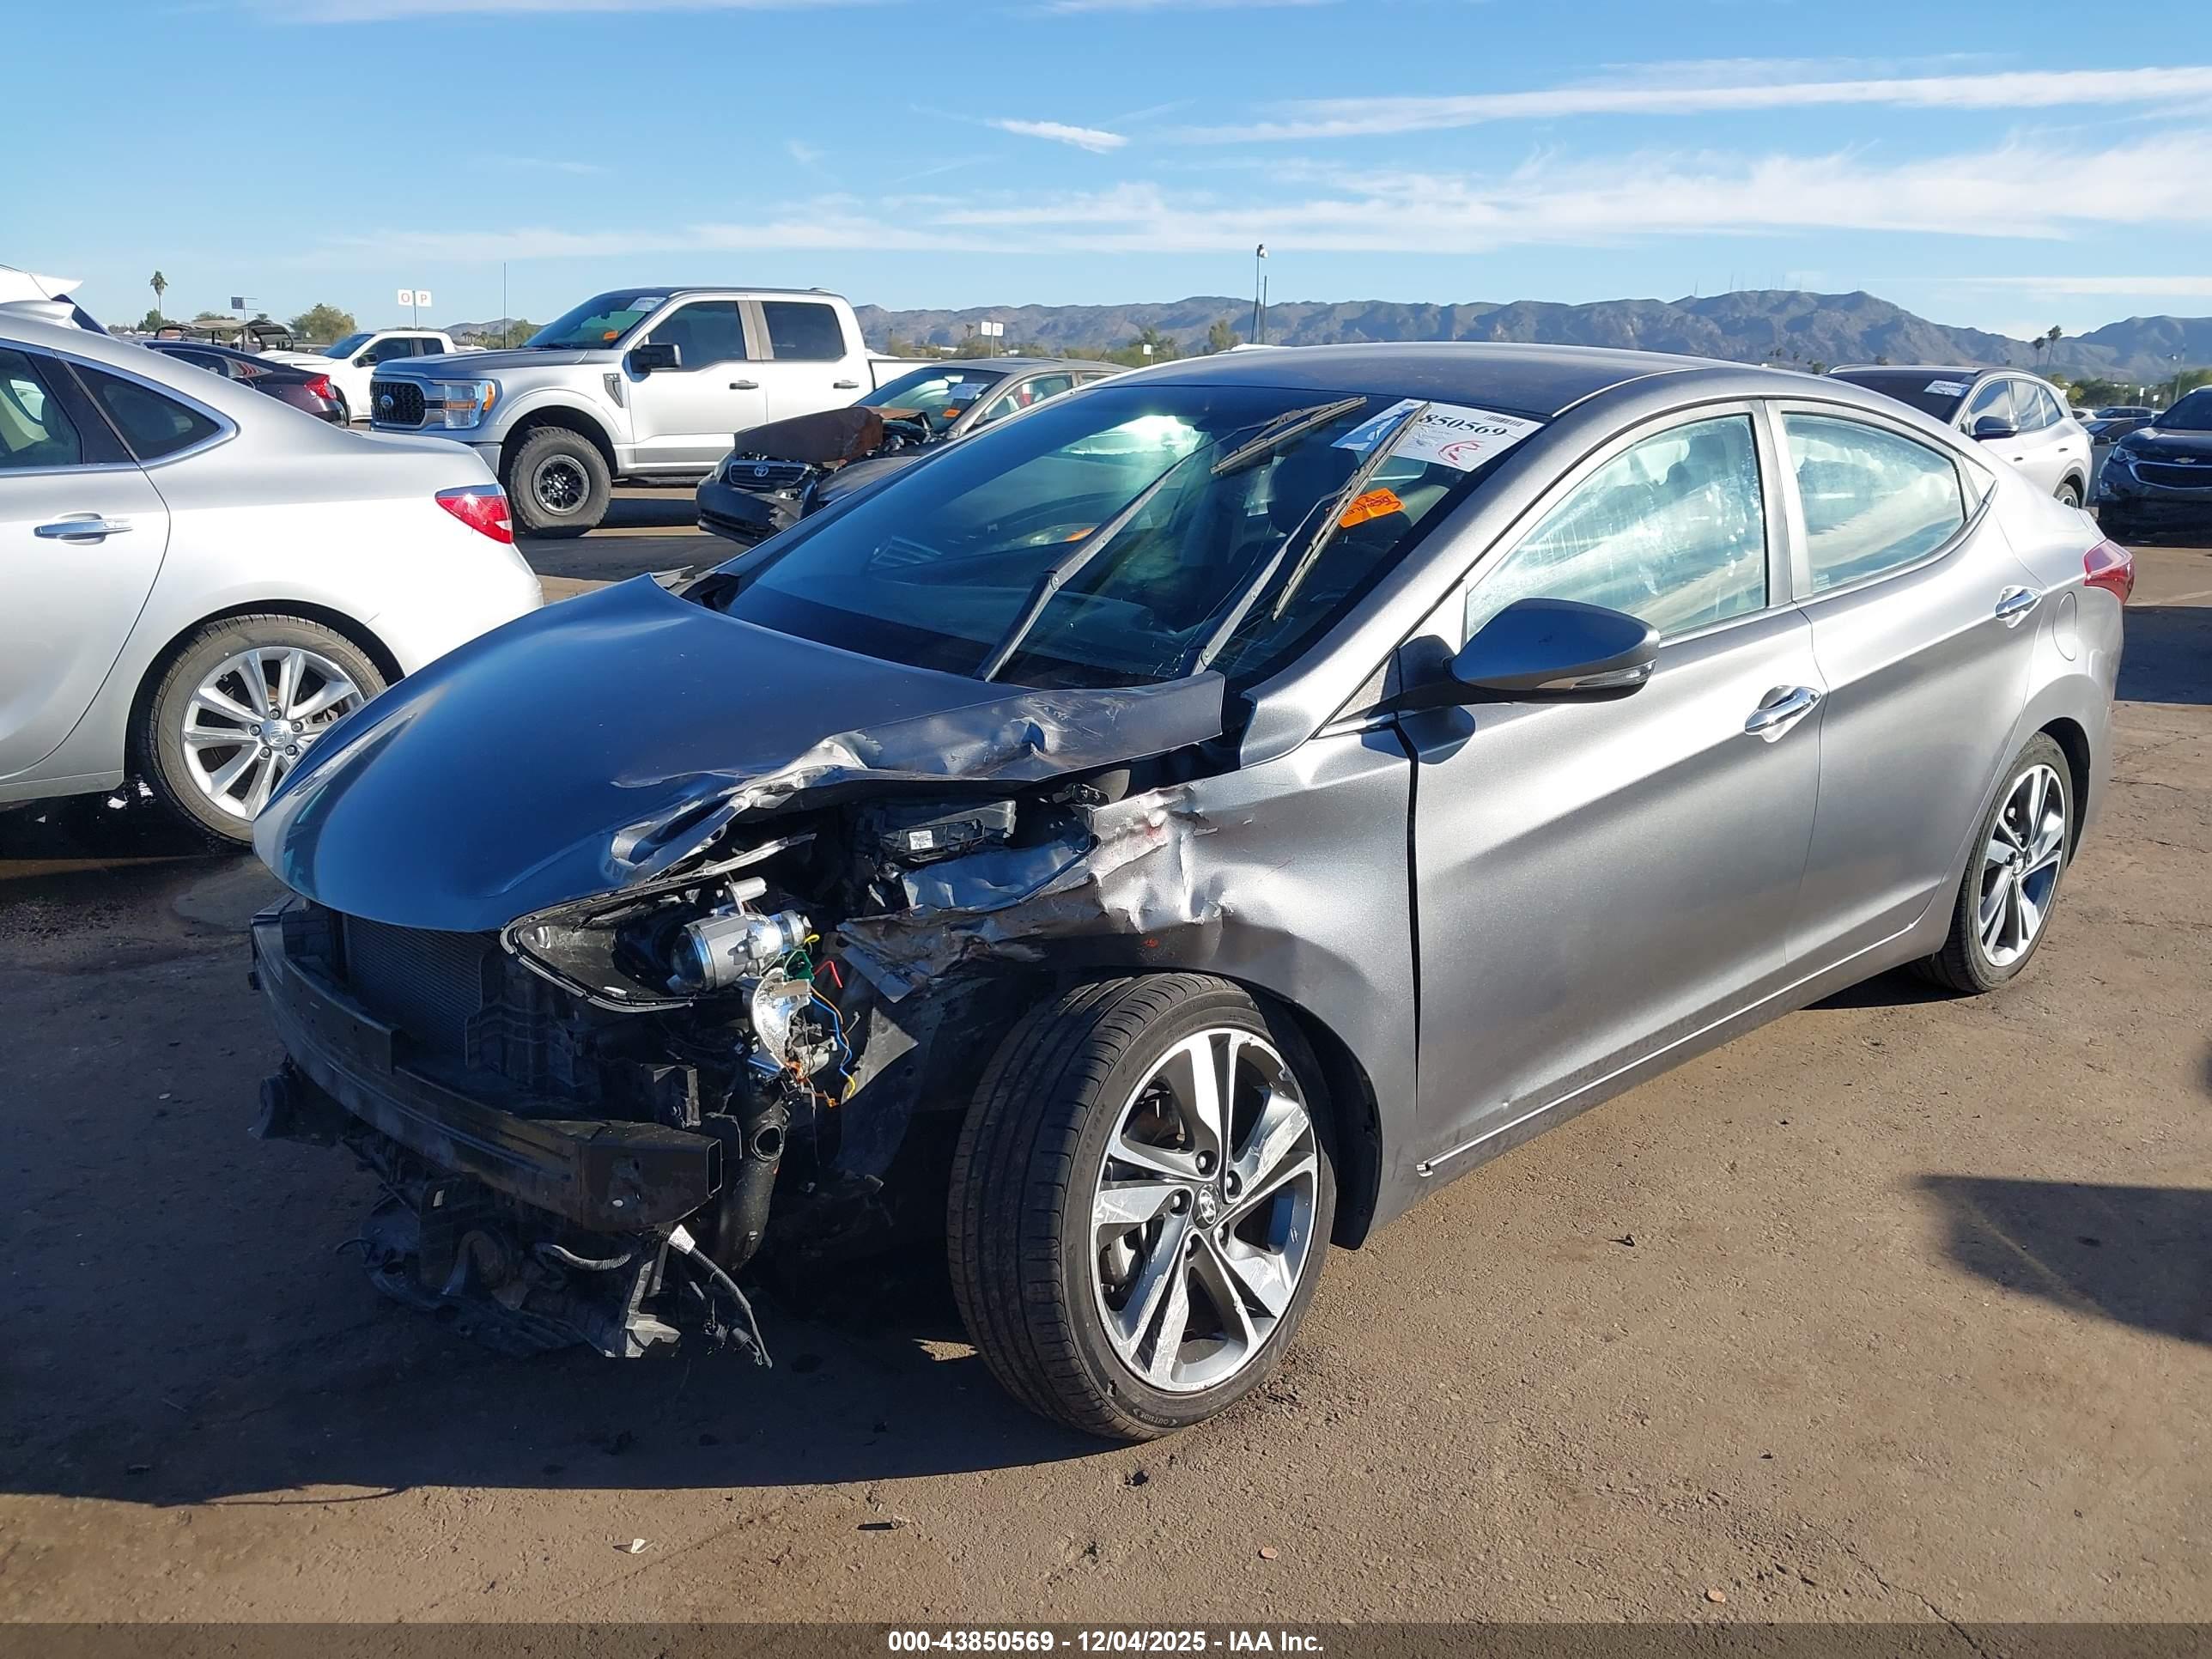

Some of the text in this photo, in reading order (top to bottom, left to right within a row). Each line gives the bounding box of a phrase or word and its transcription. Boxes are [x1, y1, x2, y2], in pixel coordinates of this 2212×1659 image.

[420, 294, 428, 304] P
[1419, 414, 1508, 436] 850569
[1139, 1411, 1169, 1426] OUTSIDE
